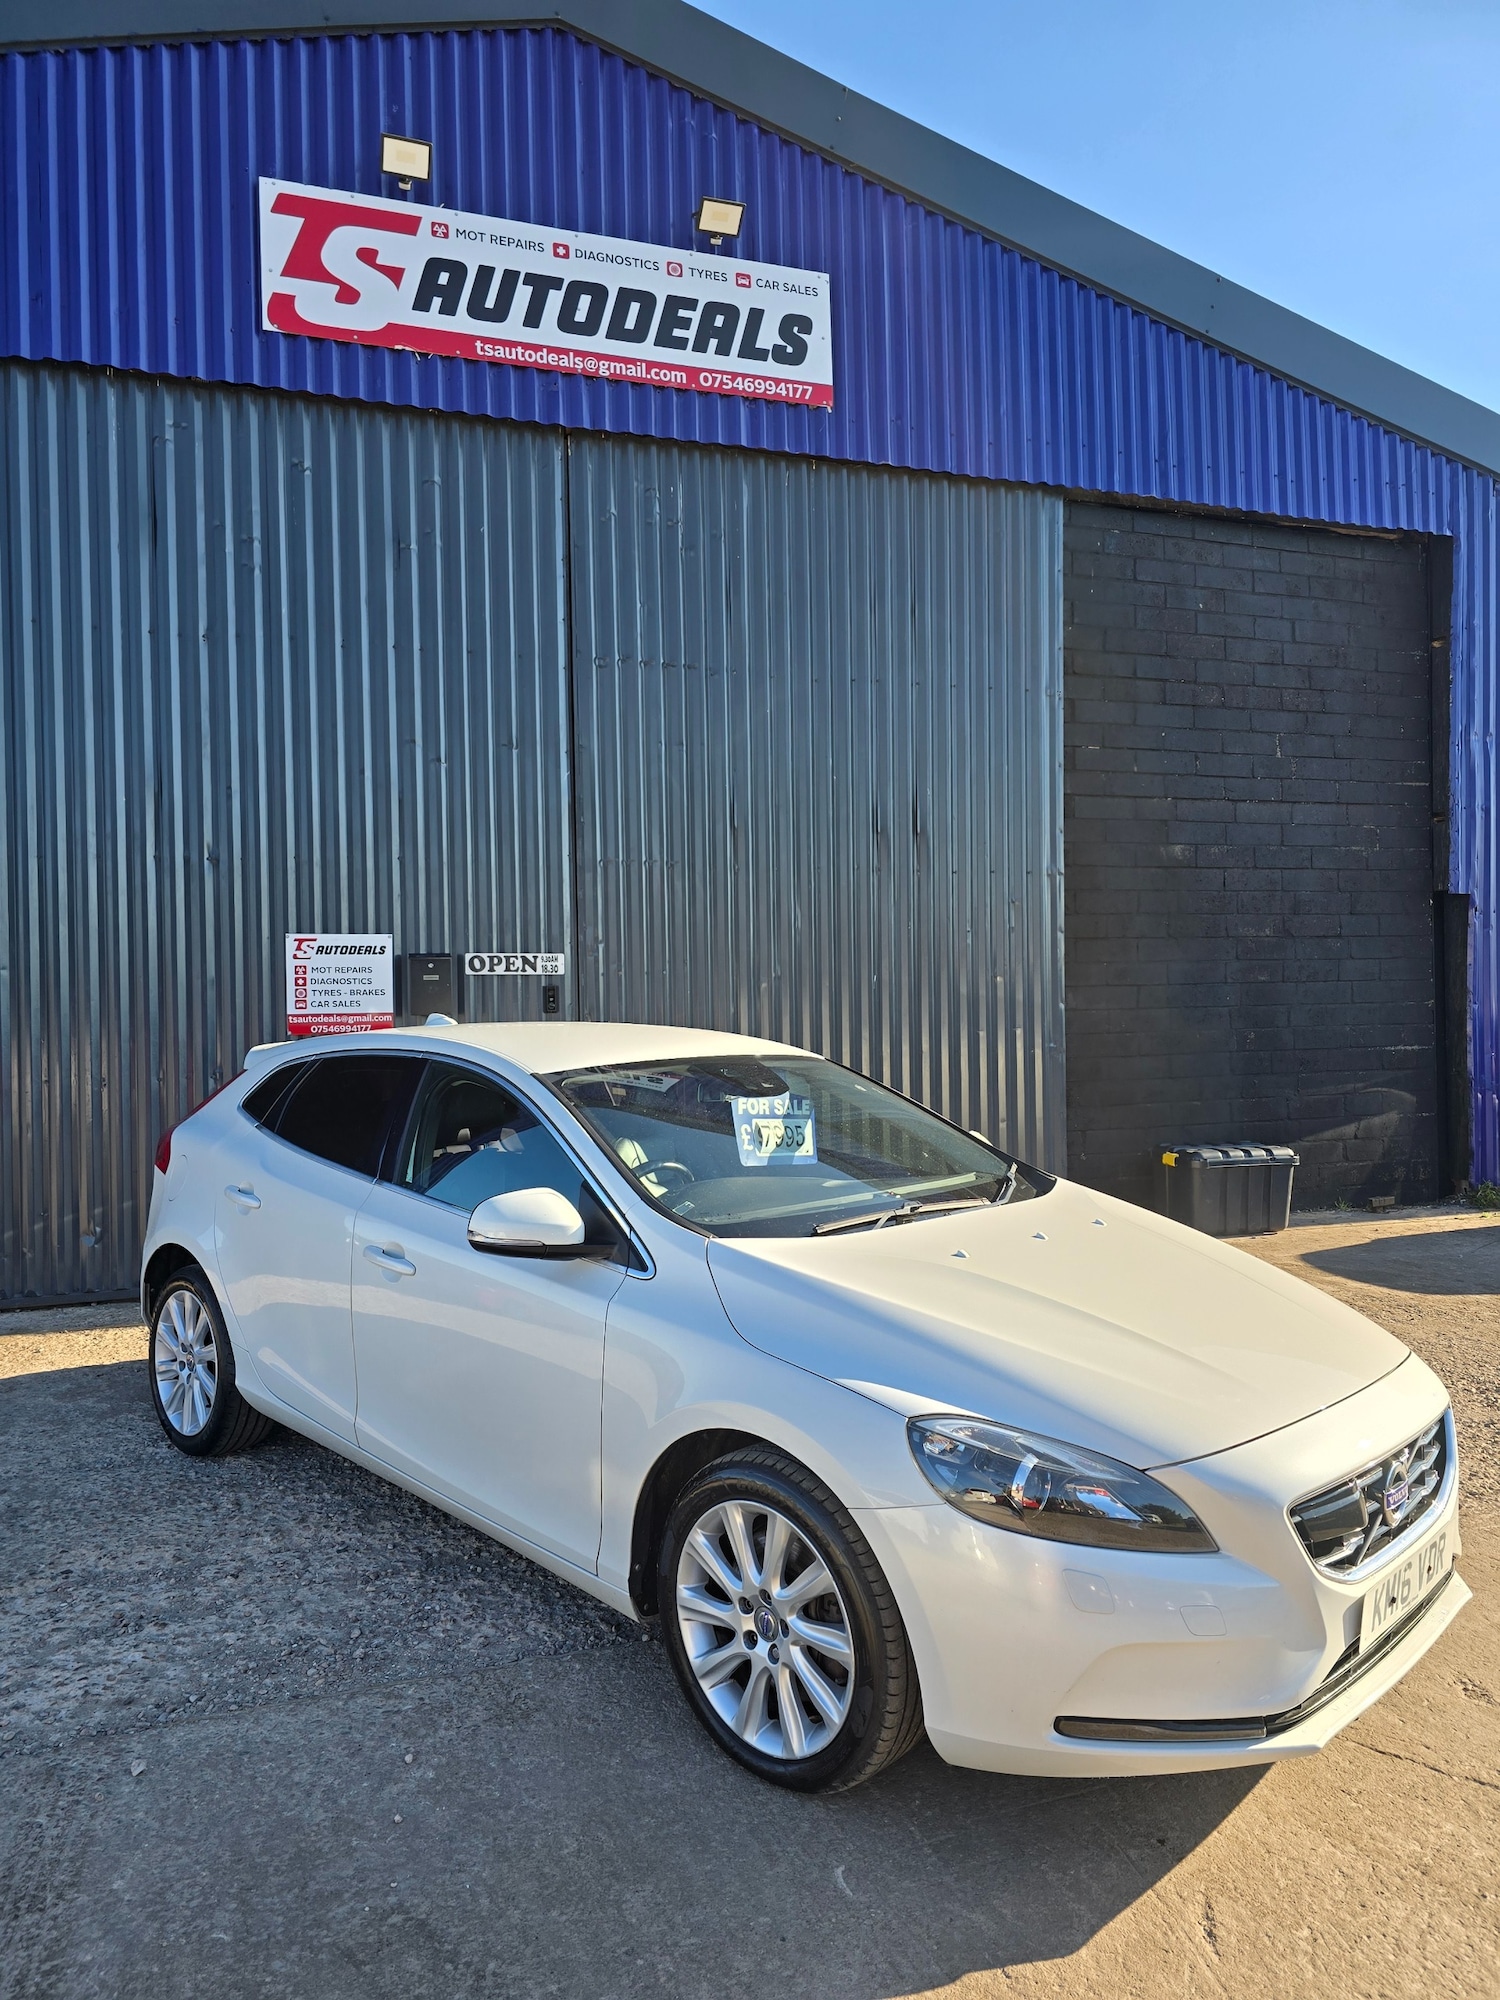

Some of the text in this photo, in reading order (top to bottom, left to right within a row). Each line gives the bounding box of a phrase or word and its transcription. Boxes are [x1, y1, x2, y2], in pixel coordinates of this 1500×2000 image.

[456, 228, 819, 297] MOT REPAIRS DIAGNOSTICS TYRES CAR SALES
[412, 256, 813, 366] AUTODEALS
[475, 339, 813, 400] tsautodeals@gmail.com 07546994177
[315, 945, 387, 955] AUTODEALS
[468, 954, 539, 973] OPEN
[311, 966, 373, 974] MOT REPAIRS
[310, 977, 373, 985] DIAGNOSTICS
[311, 989, 342, 997] TYRES
[349, 988, 386, 996] BRAKES
[310, 1000, 361, 1008] CAR SALES
[288, 1014, 392, 1024] tsautodeals@gmail.com
[310, 1024, 372, 1033] 07546994177
[737, 1097, 811, 1115] FOR SALE
[1418, 1531, 1447, 1592] VDR
